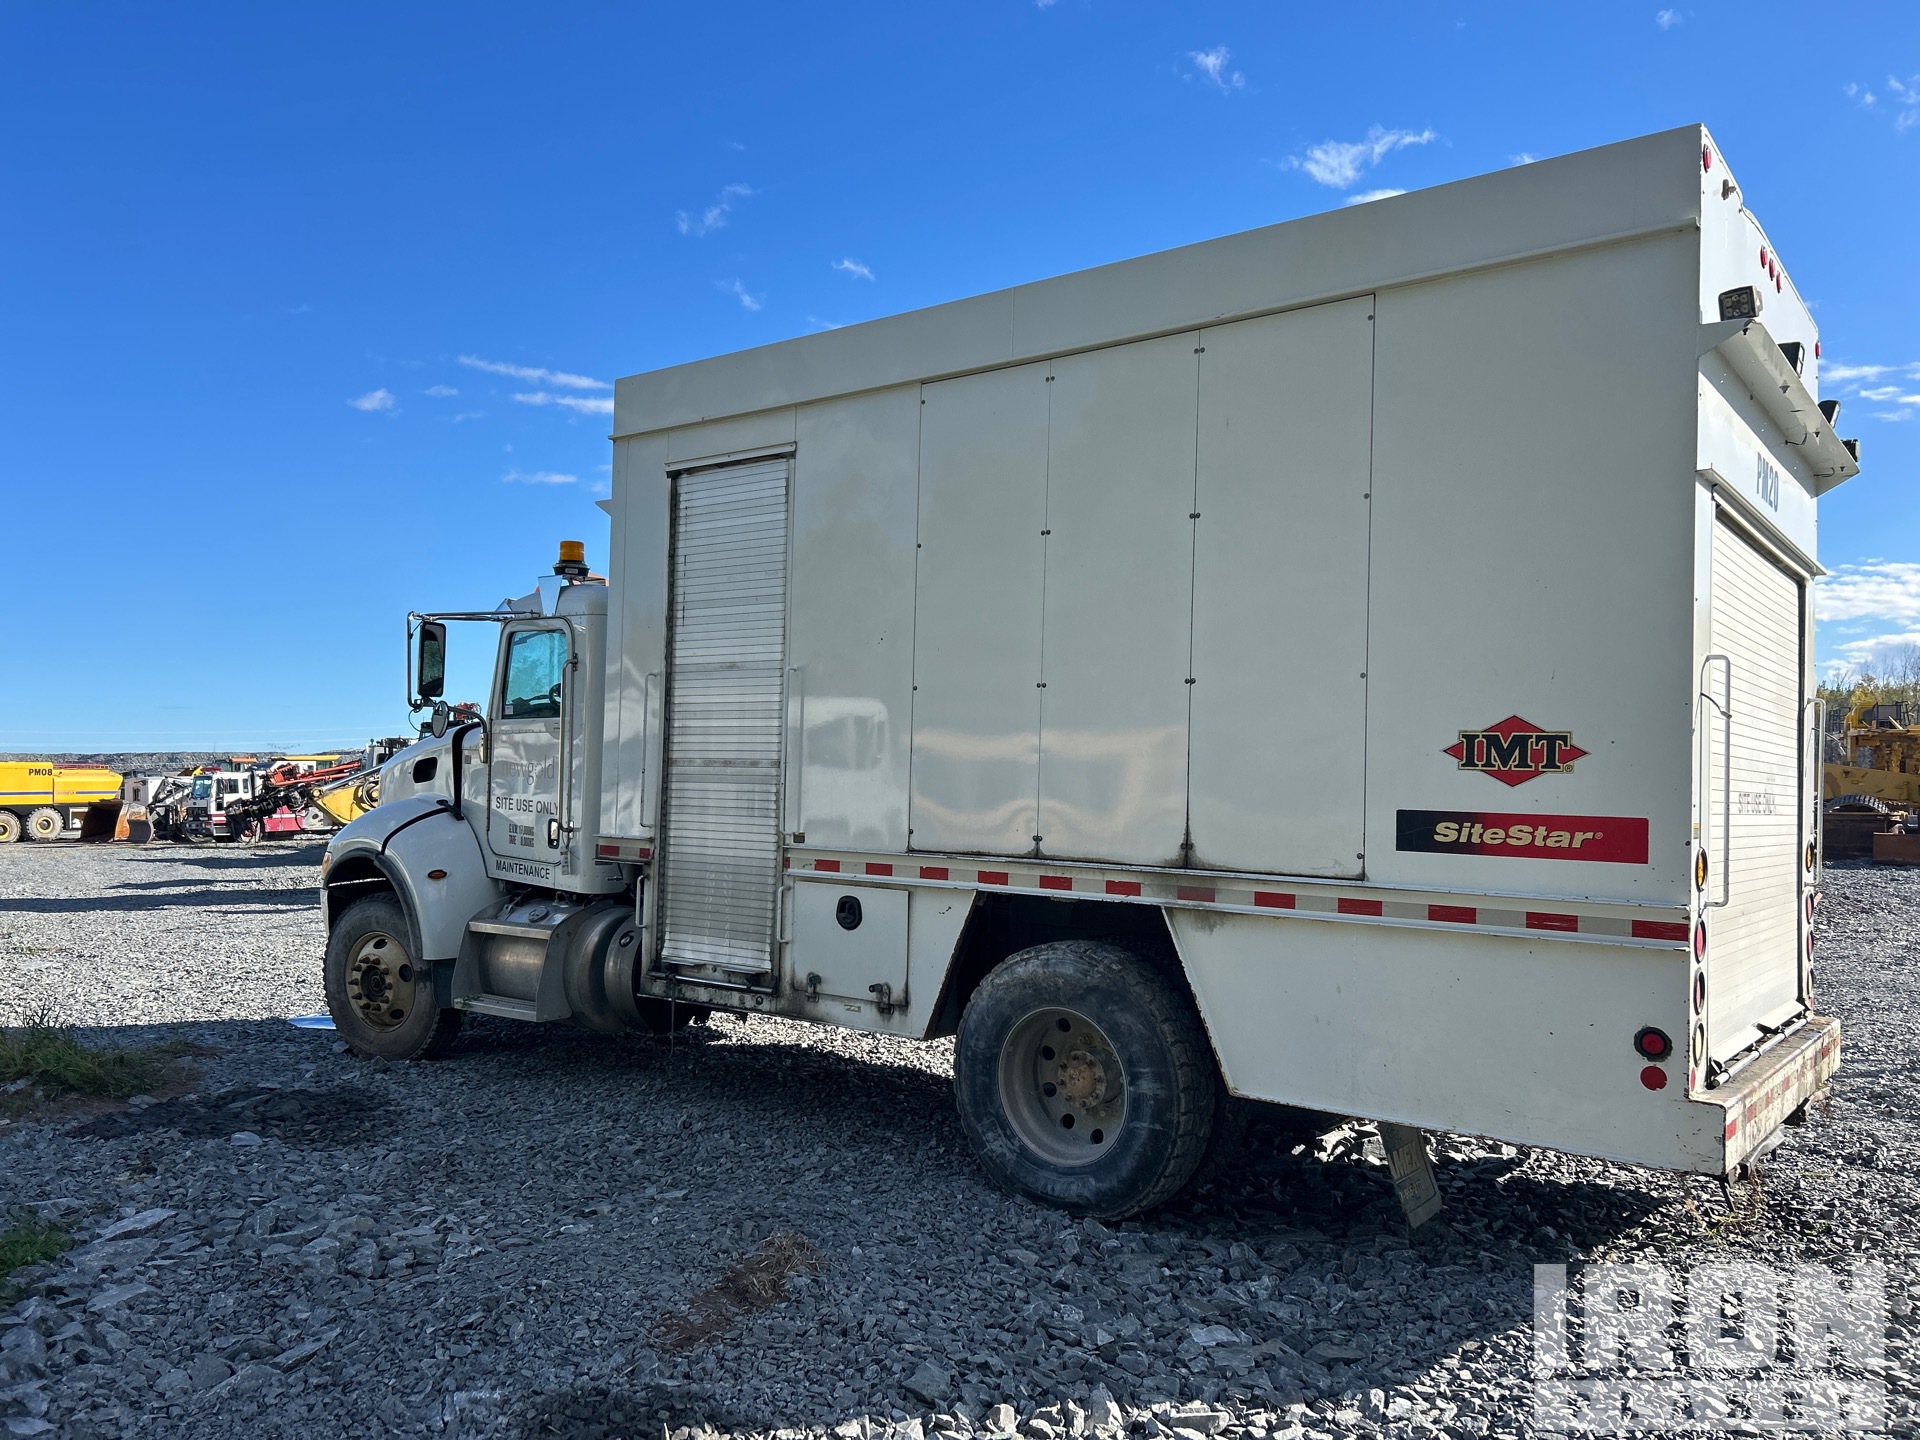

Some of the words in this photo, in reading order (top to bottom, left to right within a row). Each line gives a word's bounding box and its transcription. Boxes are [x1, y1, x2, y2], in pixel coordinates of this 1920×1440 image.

[1756, 451, 1779, 512] PM20
[1459, 731, 1571, 771] IMT
[28, 768, 53, 777] PM08
[495, 796, 514, 811] SITE
[516, 798, 533, 813] USE
[536, 801, 558, 816] ONLY
[1434, 821, 1594, 848] SiteStar
[495, 860, 550, 879] MAINTENANCE
